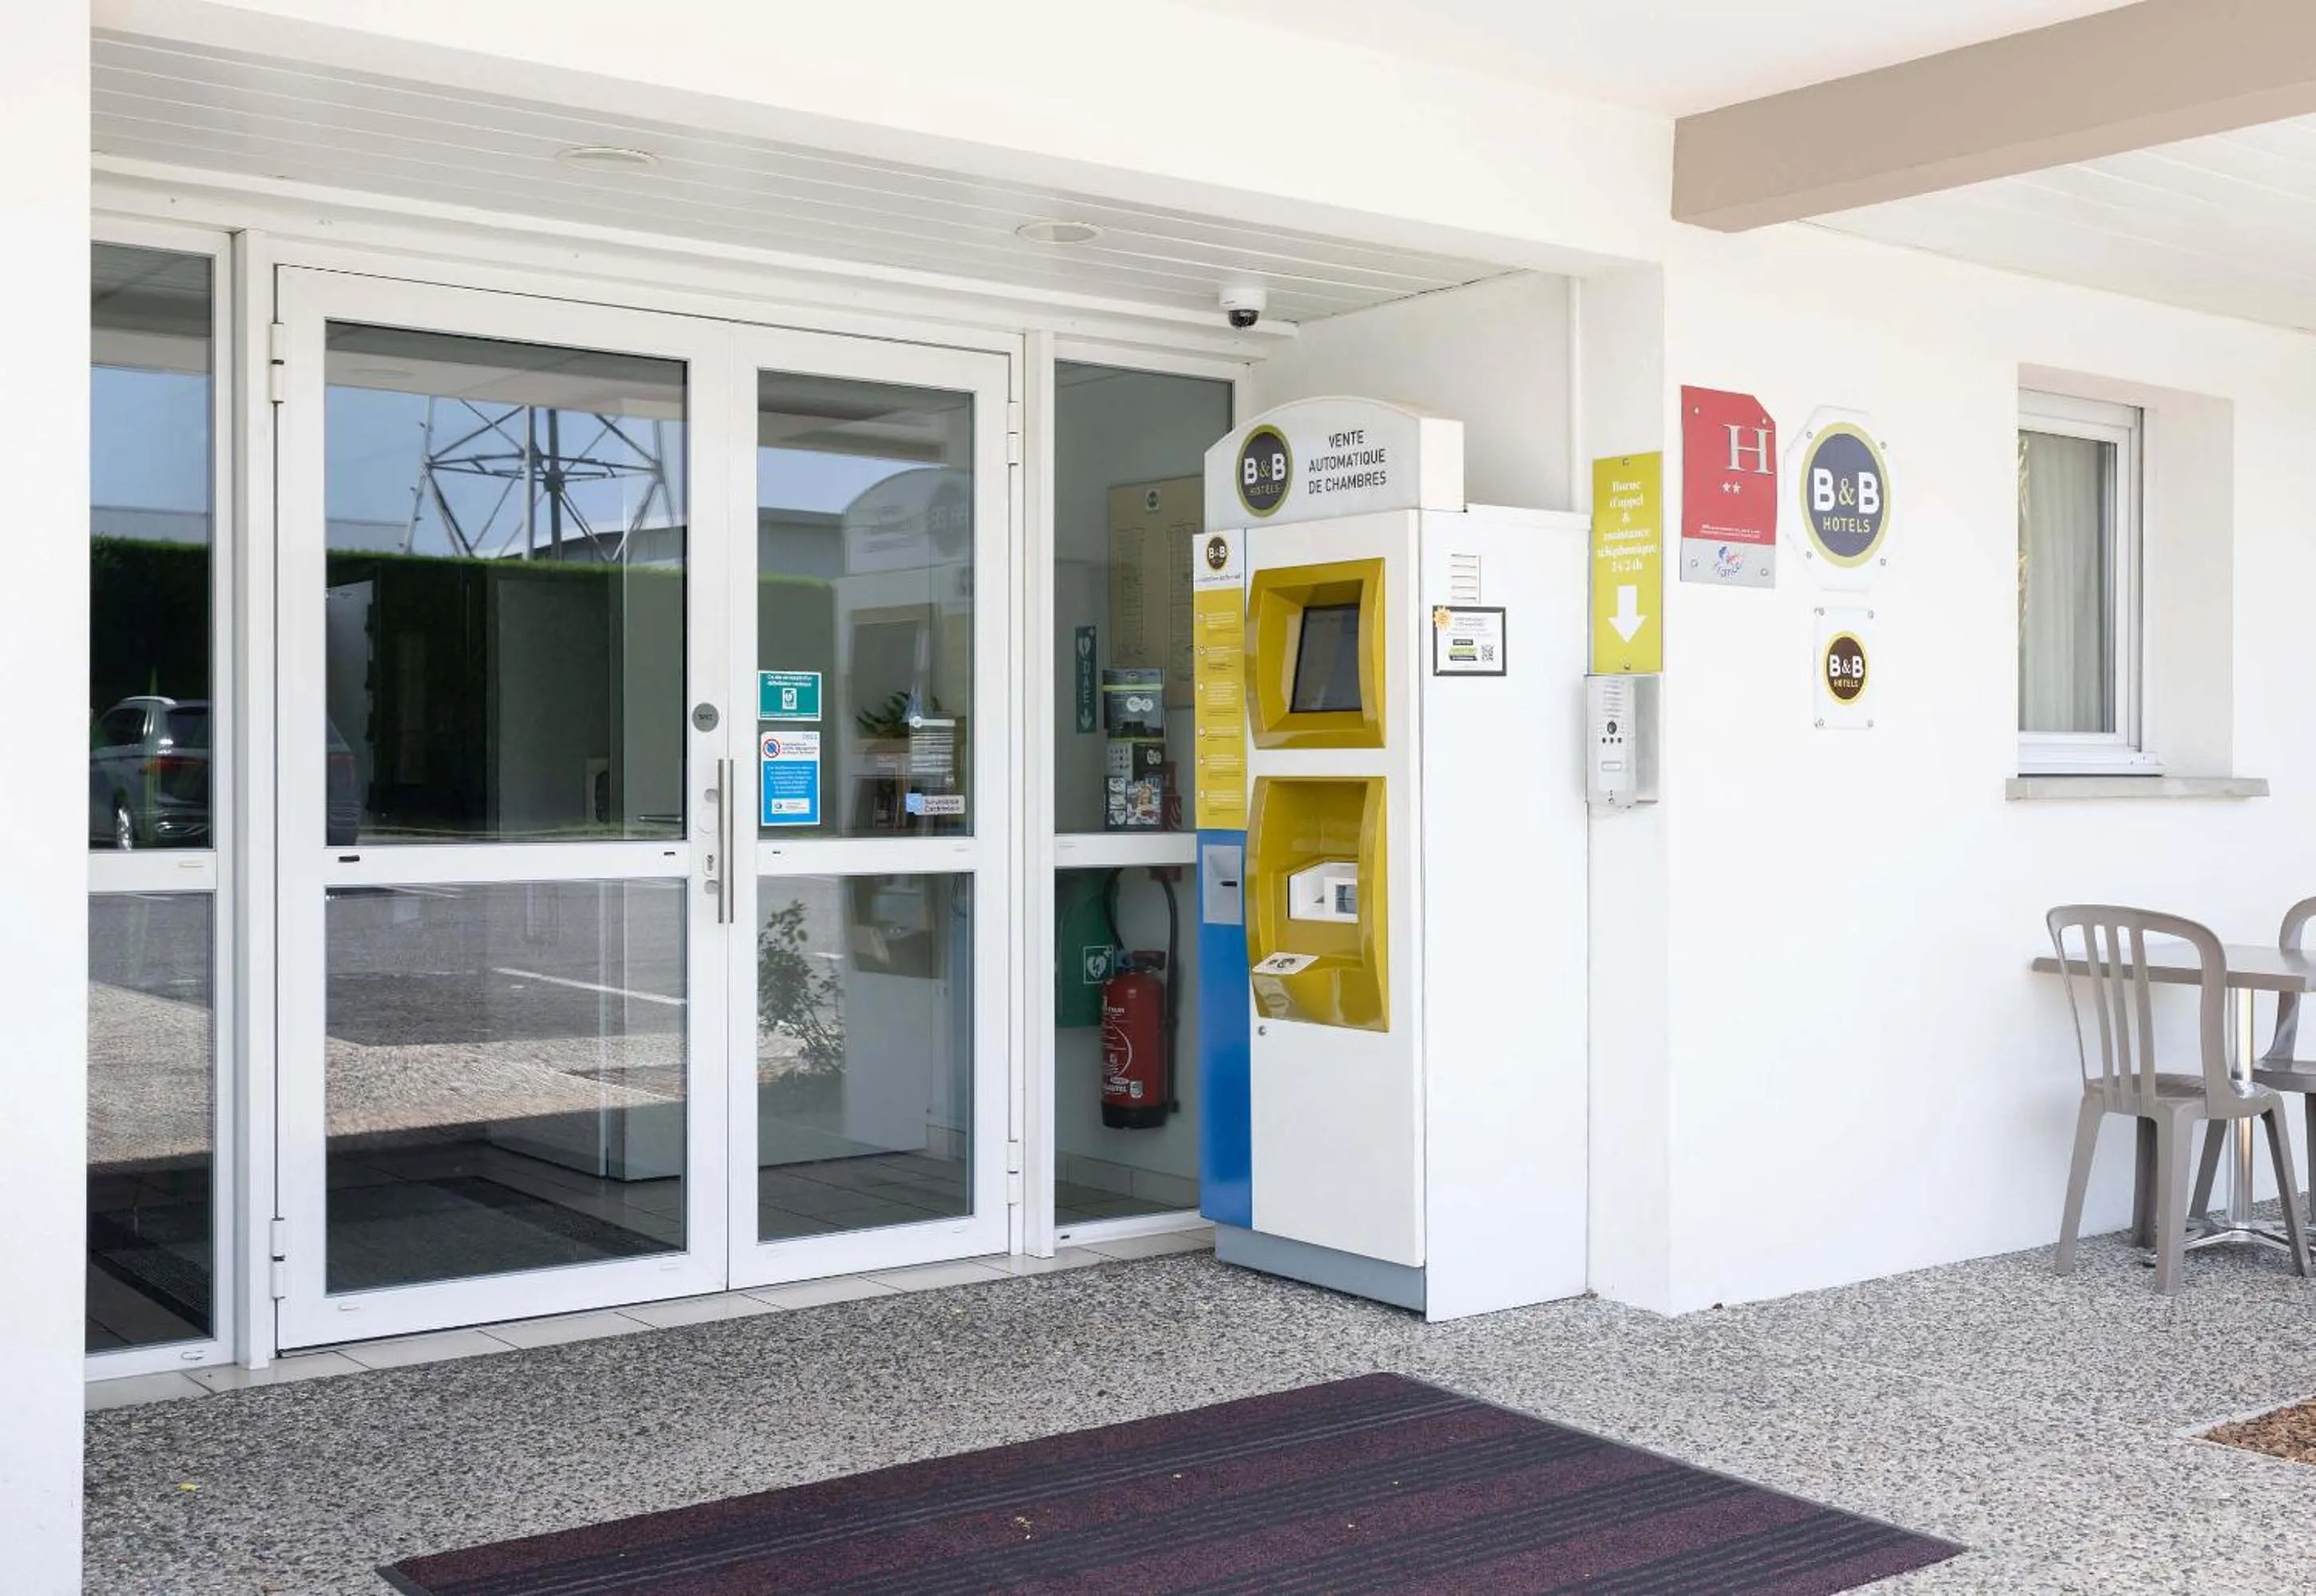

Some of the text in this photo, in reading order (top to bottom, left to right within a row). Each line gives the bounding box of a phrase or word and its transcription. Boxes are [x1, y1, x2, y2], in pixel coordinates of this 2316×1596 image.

[1329, 430, 1364, 448] VENTE
[1723, 424, 1776, 475] H
[1244, 453, 1286, 485] B&B
[1309, 449, 1386, 473] AUTOMATIQUE
[1309, 470, 1386, 494] DE CHAMBRES
[1813, 467, 1880, 513] B&B
[1822, 517, 1871, 533] HOTELS
[1830, 655, 1864, 678] B&B
